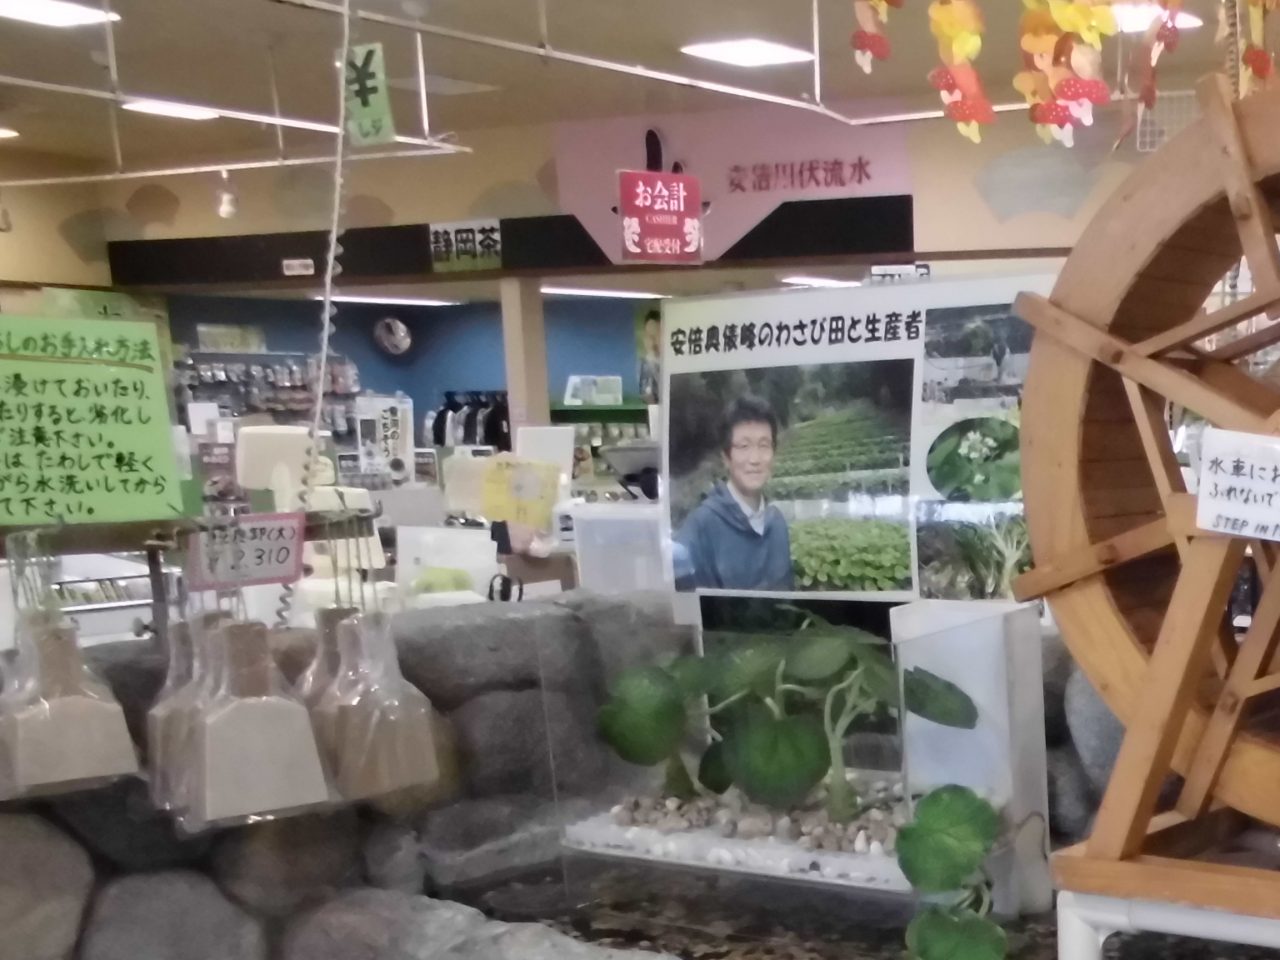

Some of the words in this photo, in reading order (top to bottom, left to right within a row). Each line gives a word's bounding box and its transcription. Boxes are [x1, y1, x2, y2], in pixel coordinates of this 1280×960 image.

[635, 180, 687, 212] お会計
[431, 225, 501, 259] 静岡茶
[1212, 513, 1249, 534] STEP
[1254, 522, 1270, 534] IN
